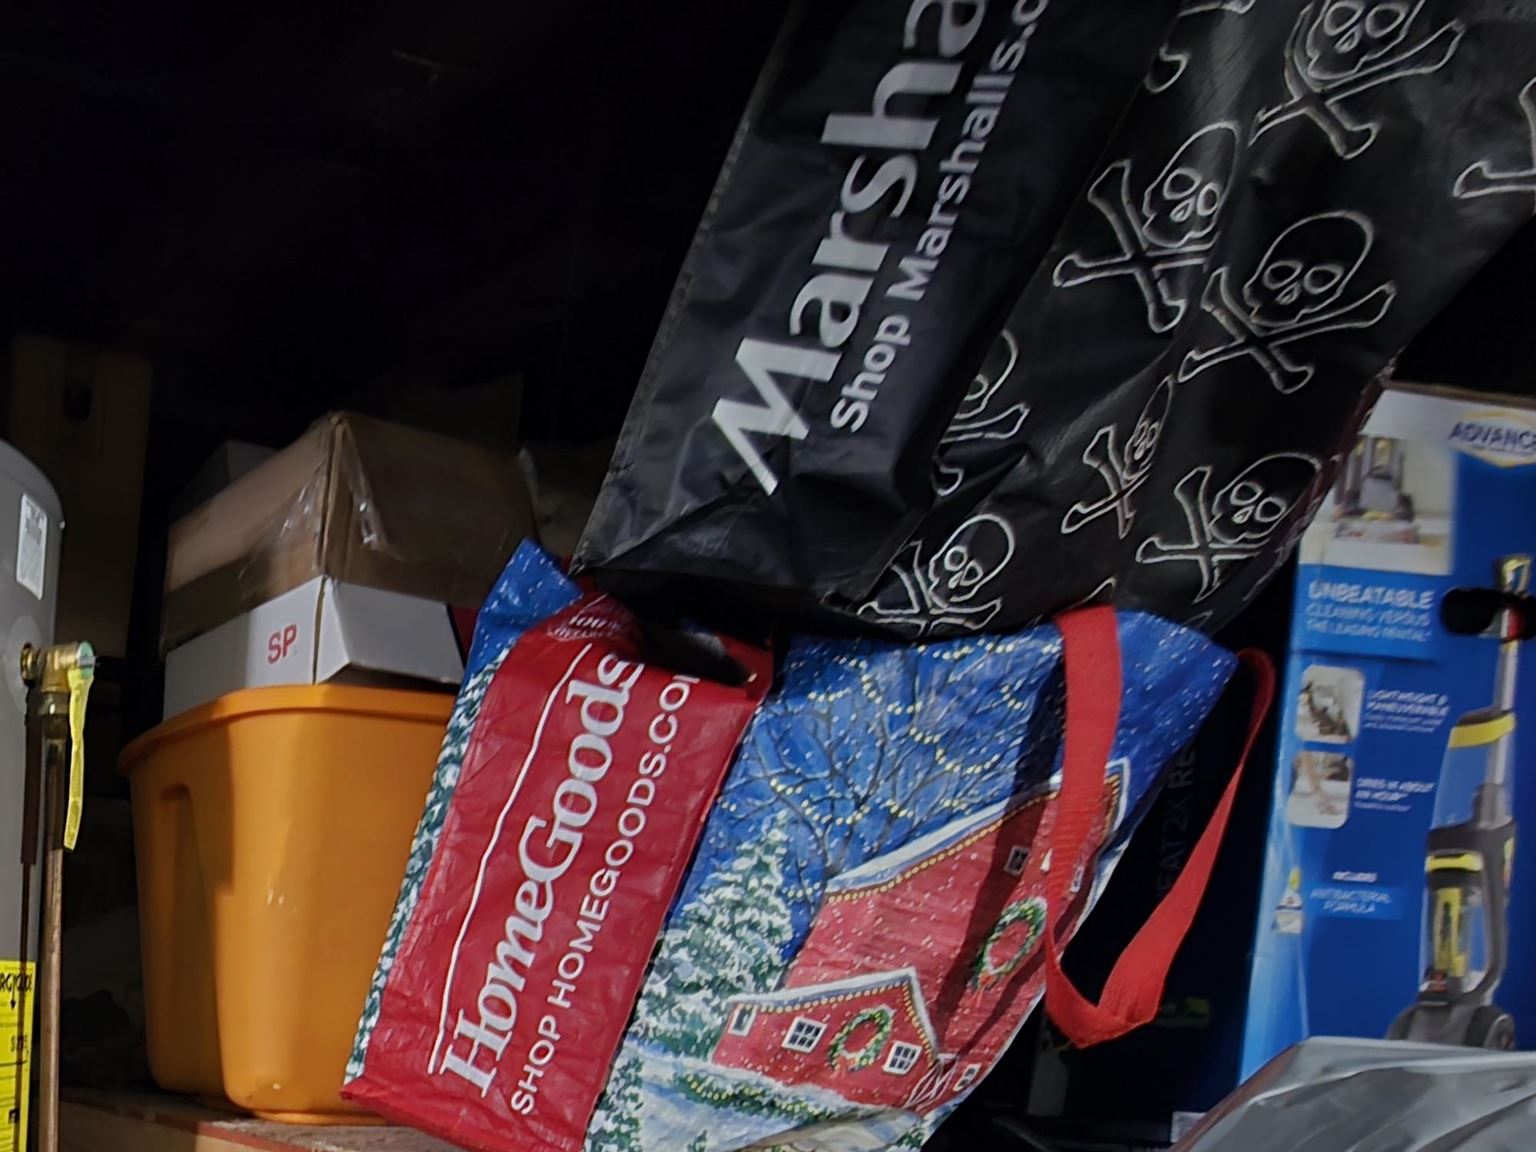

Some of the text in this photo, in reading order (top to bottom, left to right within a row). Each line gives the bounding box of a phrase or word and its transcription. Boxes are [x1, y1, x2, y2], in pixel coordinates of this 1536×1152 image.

[831, 313, 912, 434] Shop
[267, 624, 298, 664] SP
[440, 653, 645, 1098] HomeGoods
[511, 1015, 561, 1116] SHOP
